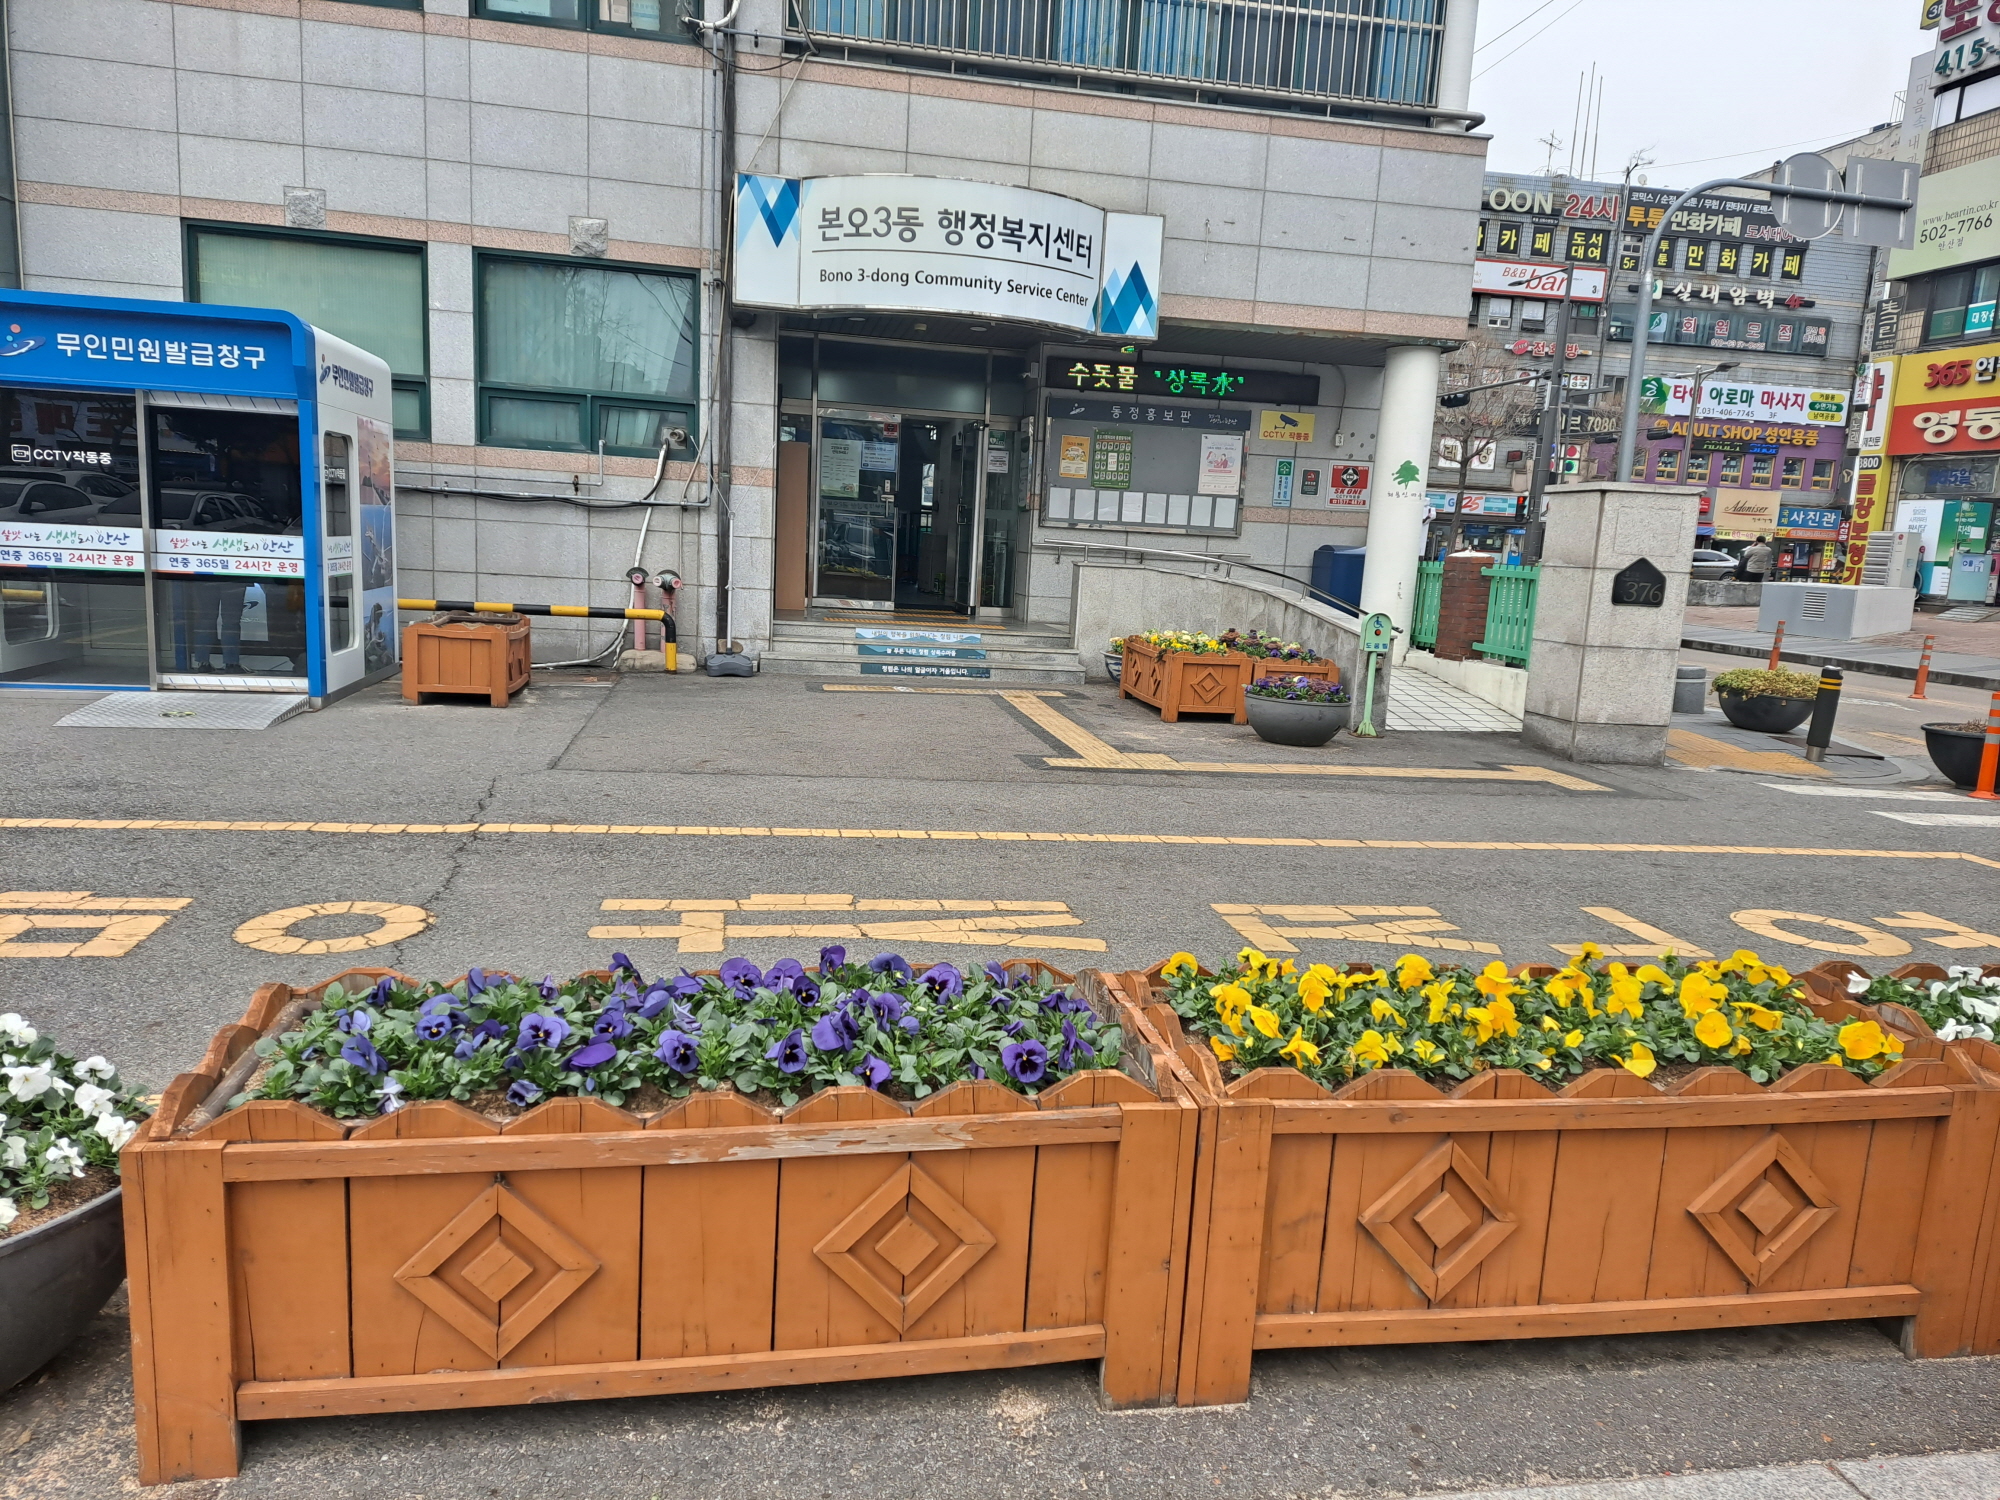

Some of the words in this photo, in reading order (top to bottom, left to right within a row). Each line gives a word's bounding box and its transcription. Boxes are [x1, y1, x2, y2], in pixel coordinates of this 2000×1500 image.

[1935, 32, 2000, 75] 415-
[1484, 186, 1553, 214] OON
[1564, 193, 1619, 222] 24시
[1671, 211, 1742, 237] 만화카페
[1922, 199, 2000, 227] www.heartin.co.kr
[817, 205, 924, 243] 본오3동
[937, 207, 1093, 269] 행정복지센터
[1919, 213, 1993, 243] 502-7766
[1502, 266, 1528, 279] B&B
[1622, 257, 1636, 270] 5F
[819, 268, 853, 284] Bono
[857, 268, 910, 287] 3-dong
[914, 269, 1002, 294] Community
[1006, 278, 1053, 300] Service
[1056, 286, 1089, 307] Center
[56, 333, 266, 370] 무인민원발급창구
[1068, 362, 1140, 390] 수돗물
[1924, 359, 1973, 389] 365
[1975, 356, 2000, 382] 연
[1709, 387, 1755, 407] 아로마
[1760, 391, 1806, 411] 마사지
[1263, 430, 1286, 439] CCTV
[1672, 422, 1719, 438] ADULT
[1723, 425, 1763, 441] SHOP
[1765, 427, 1820, 447] 성인용품
[33, 448, 113, 465] CCTV작동중
[1448, 495, 1484, 512] G25
[1790, 510, 1837, 527] 사진관
[97, 532, 131, 546] 안산
[262, 540, 294, 553] 안산
[0, 549, 23, 562] 연중
[28, 550, 63, 563] 365일
[68, 553, 107, 565] 24시간
[112, 554, 135, 567] 운영
[169, 557, 191, 569] 연중
[196, 558, 229, 570] 365일
[235, 560, 272, 572] 24시간
[277, 561, 298, 573] 운영
[1623, 581, 1662, 603] 376
